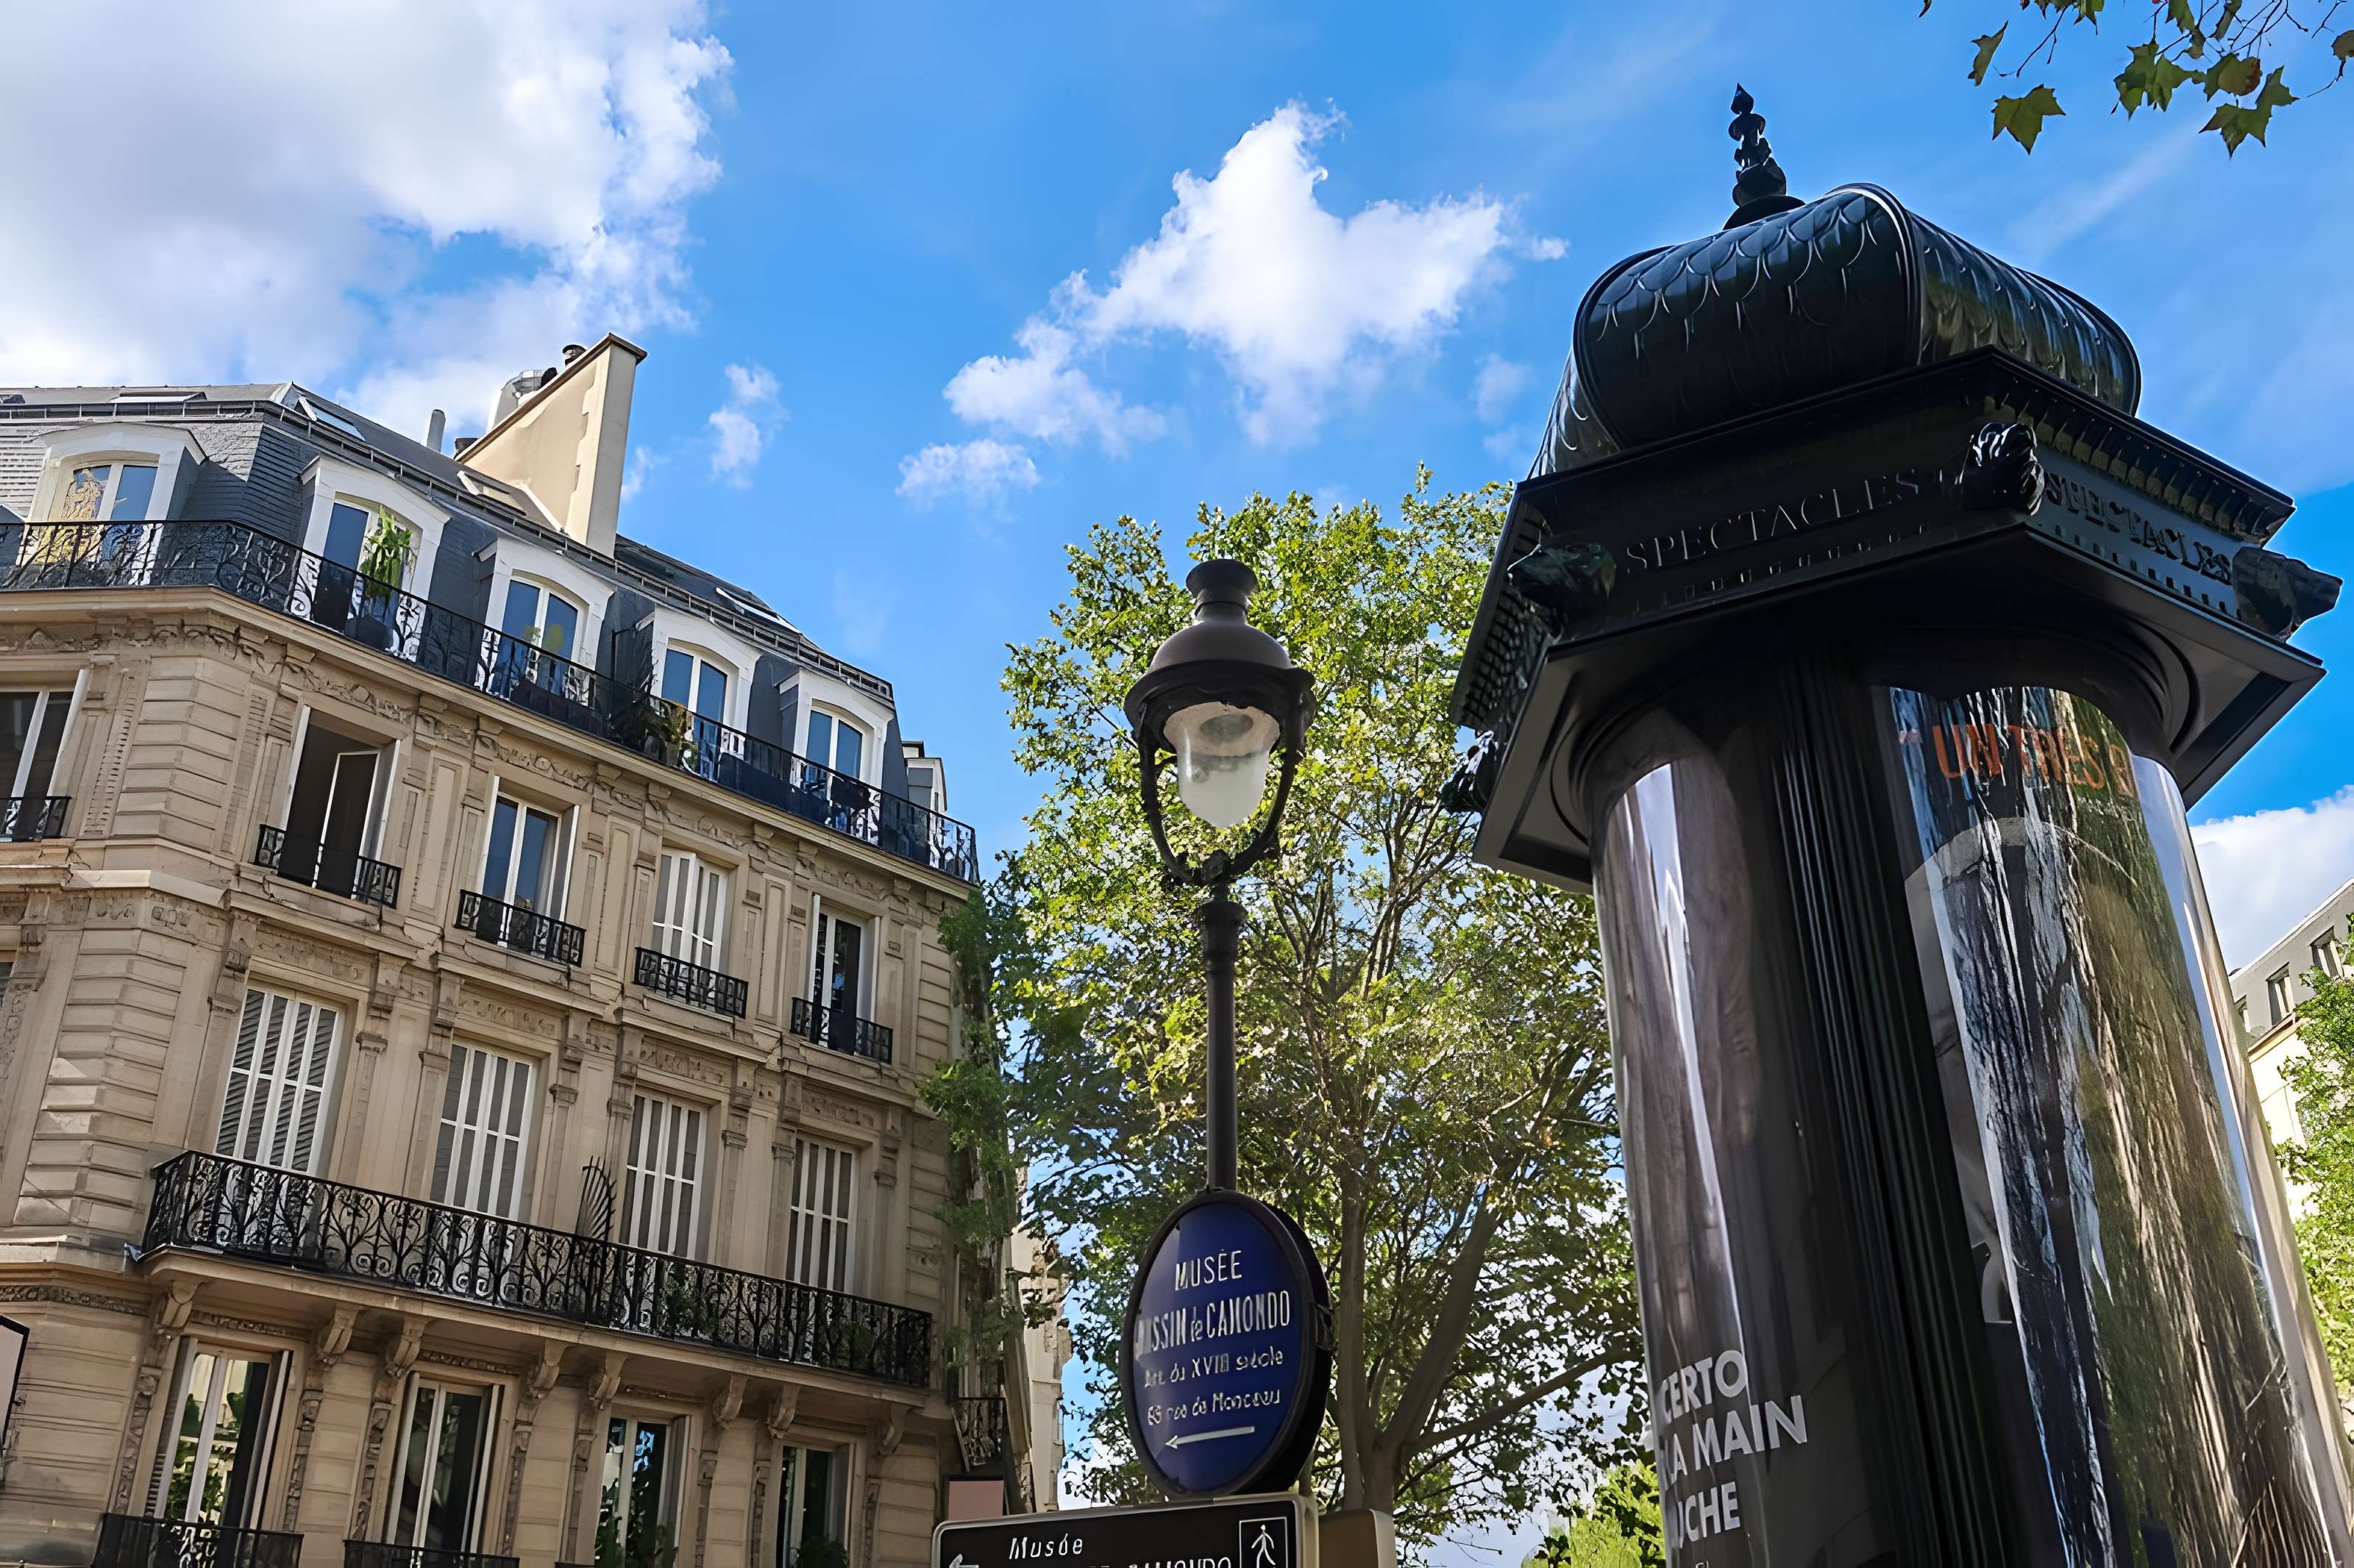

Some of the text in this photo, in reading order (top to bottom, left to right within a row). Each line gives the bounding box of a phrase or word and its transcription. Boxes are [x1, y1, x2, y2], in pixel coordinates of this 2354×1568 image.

[1626, 468, 1919, 574] SPECTACLES
[2044, 471, 2233, 585] SPECTACLES
[1175, 1249, 1242, 1291] MUSÉE
[1692, 1394, 1808, 1472] MAIN
[1009, 1533, 1084, 1560] Musée
